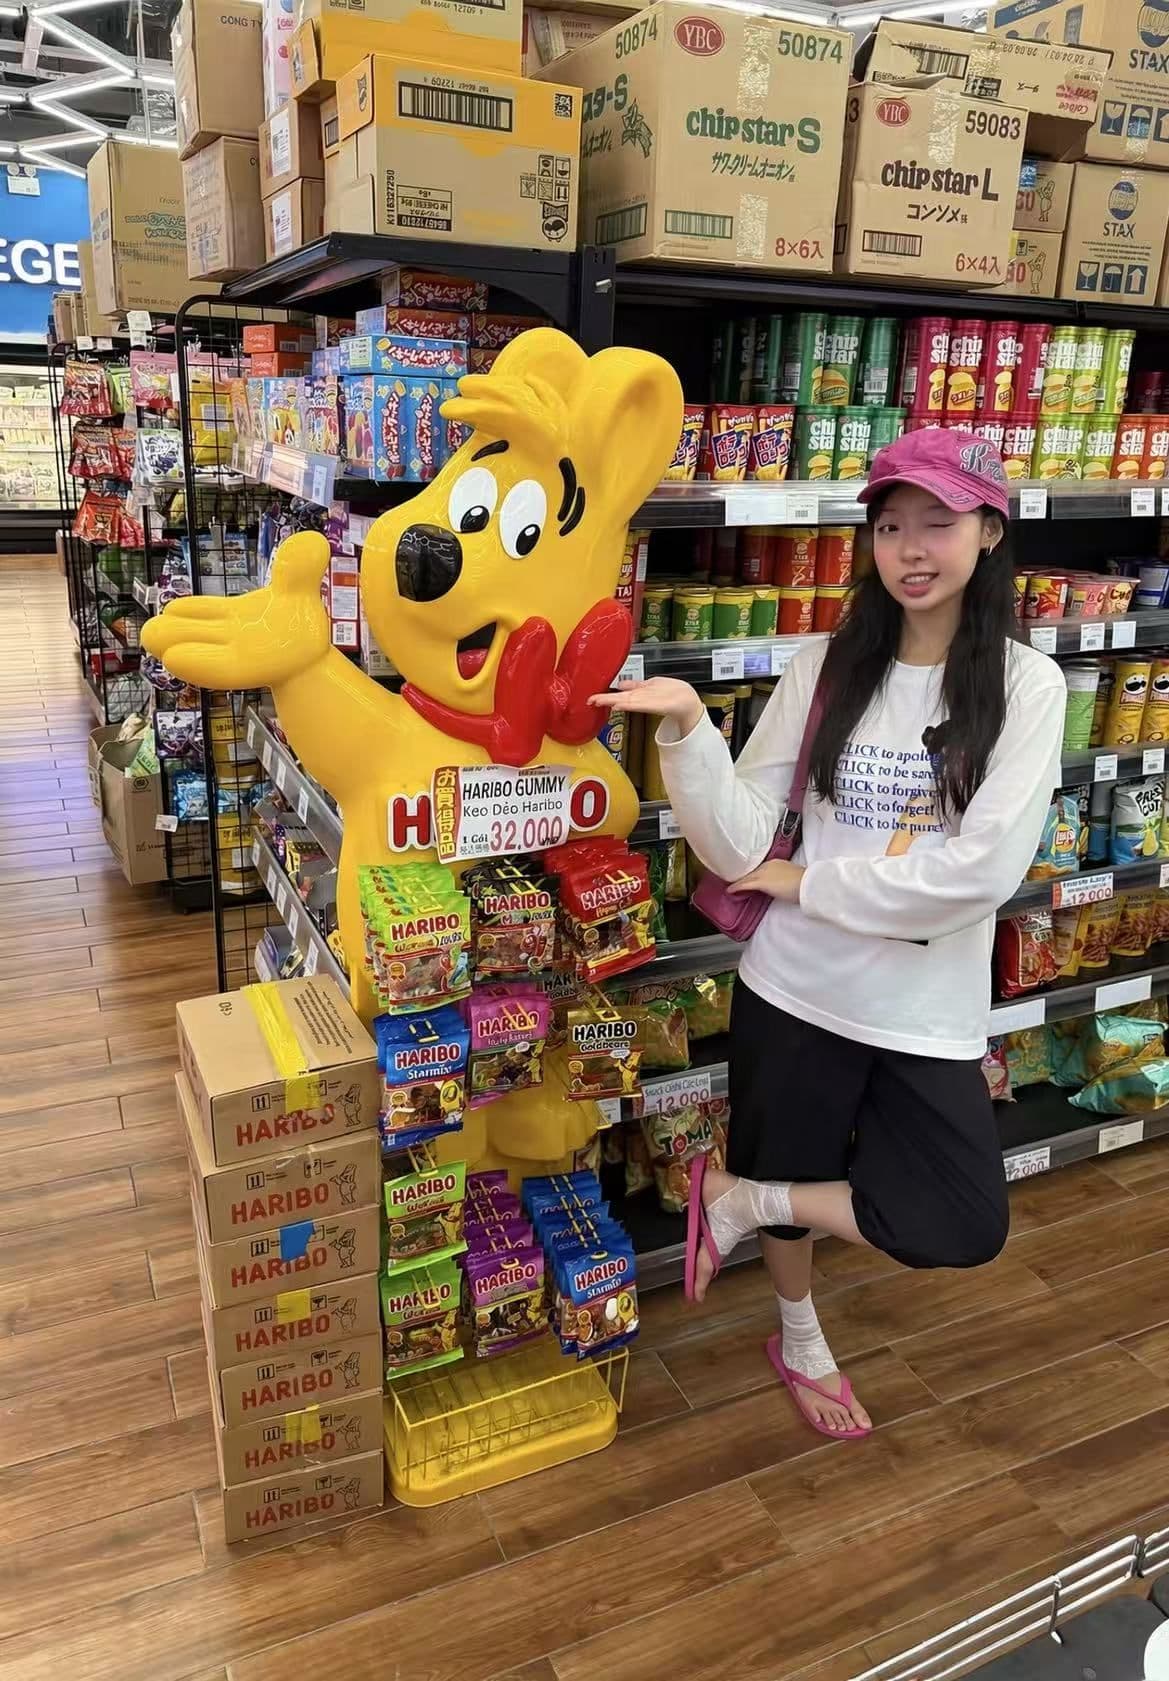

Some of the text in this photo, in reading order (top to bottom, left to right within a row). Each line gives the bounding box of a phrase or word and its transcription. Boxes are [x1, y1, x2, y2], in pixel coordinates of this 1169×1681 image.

[615, 15, 657, 59] 50874
[683, 23, 717, 51] YBC
[778, 31, 843, 63] 50874
[686, 107, 821, 154] chip star S
[965, 110, 1021, 140] 59083
[881, 160, 999, 201] chip star L
[1103, 222, 1137, 238] STAX
[881, 749, 893, 758] to
[835, 776, 873, 793] CLICK
[877, 783, 889, 794] to
[878, 765, 890, 776] to
[894, 765, 909, 778] be
[462, 775, 566, 801] HARIBO GUMMY
[836, 793, 874, 811] CLICK
[877, 799, 889, 810] to
[522, 798, 563, 813] Haribo
[834, 810, 873, 829] CLICK
[877, 816, 889, 827] to
[1143, 799, 1161, 816] CUT
[484, 890, 552, 915] HARIBO
[581, 875, 641, 911] HARIBO
[390, 913, 461, 941] HARIBO
[477, 1009, 540, 1038] HARIBO
[572, 1020, 638, 1042] HARIBO
[394, 1042, 461, 1071] HARIBO
[578, 1038, 631, 1053] Goldbears
[236, 1103, 336, 1147] HARIBO
[231, 1182, 330, 1225] HARIBO
[391, 1174, 457, 1206] HARIBO
[231, 1247, 328, 1288] HARIBO
[475, 1263, 537, 1297] HARIBO
[574, 1257, 629, 1291] HARIBO
[235, 1314, 331, 1353] HARIBO
[241, 1368, 334, 1411] HARIBO
[244, 1431, 336, 1469] HARIBO
[246, 1492, 335, 1529] HARIBO
